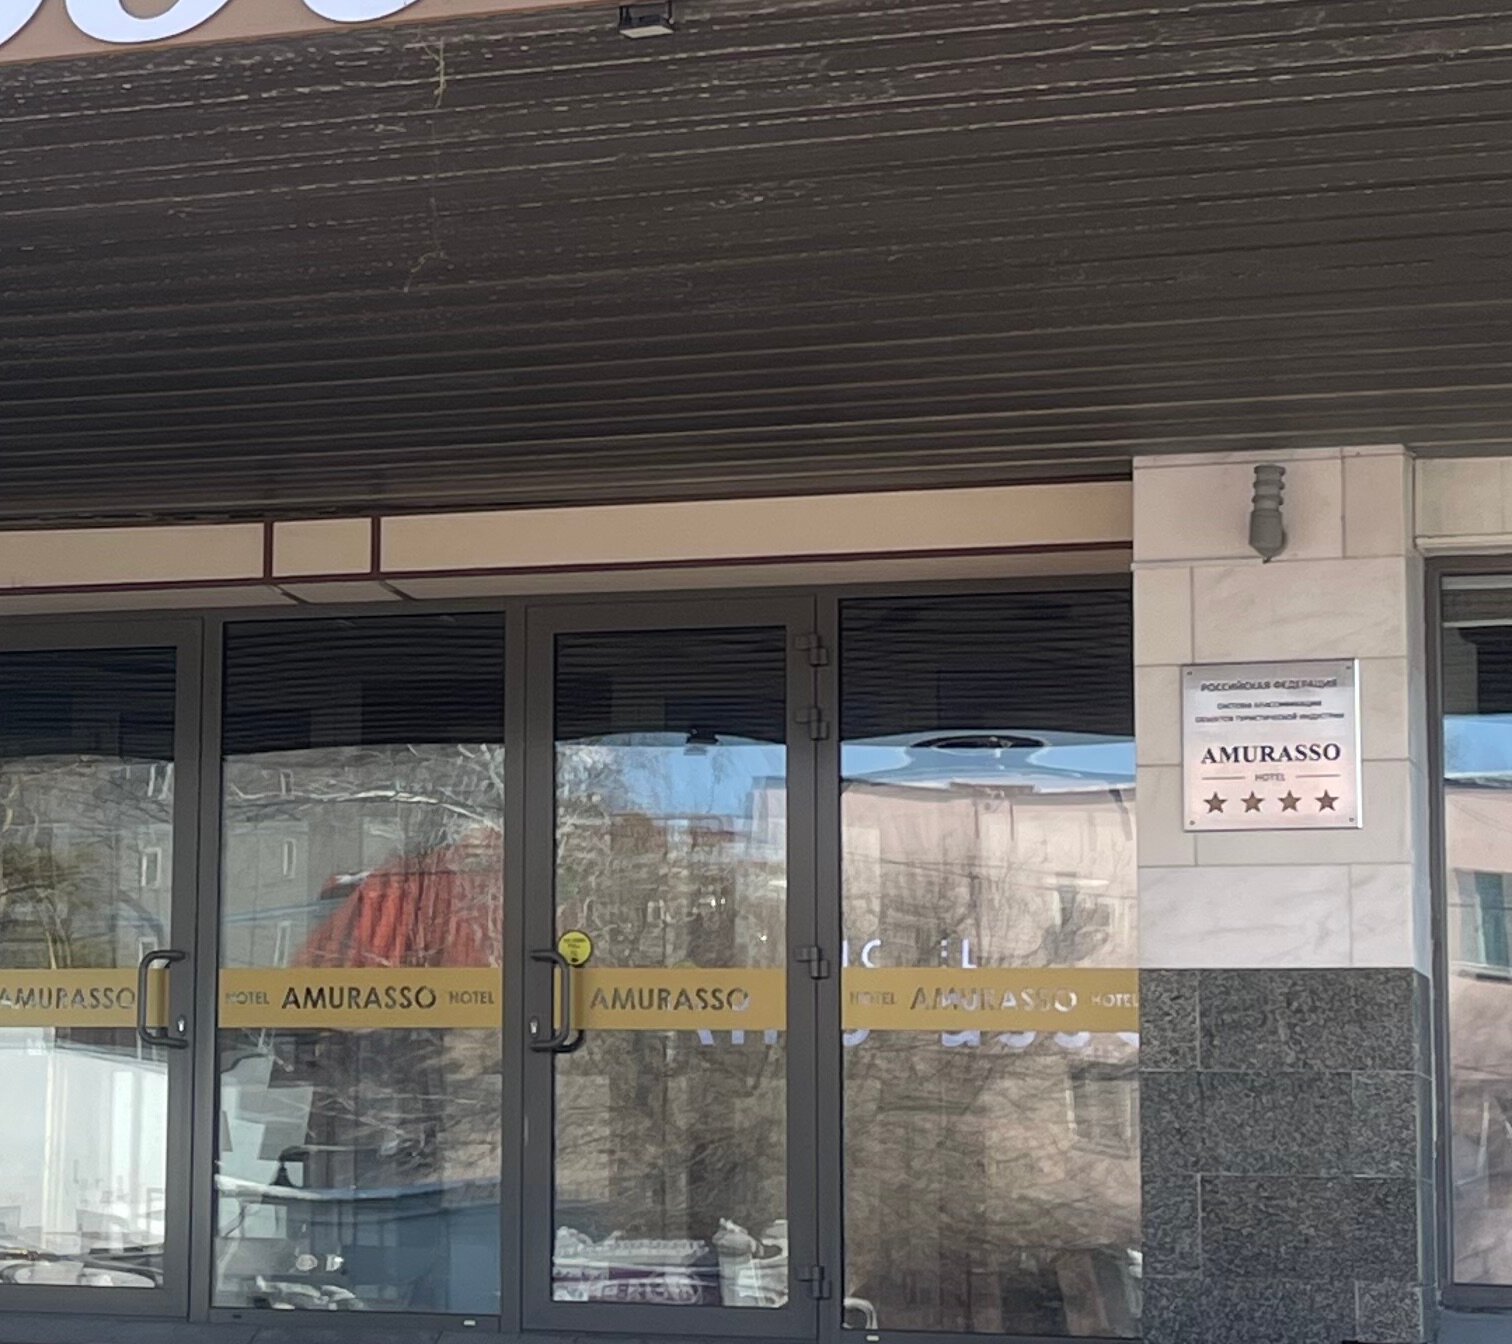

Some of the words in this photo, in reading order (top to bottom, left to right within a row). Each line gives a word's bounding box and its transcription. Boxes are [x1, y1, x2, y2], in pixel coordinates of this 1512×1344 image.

[1201, 743, 1341, 764] AMURASSO
[1254, 773, 1286, 782] HOTEL
[281, 985, 437, 1010] AMURASSO
[449, 989, 495, 1005] HOTEL
[590, 987, 749, 1011] AMURASSO
[909, 986, 1078, 1013] AMURASSO
